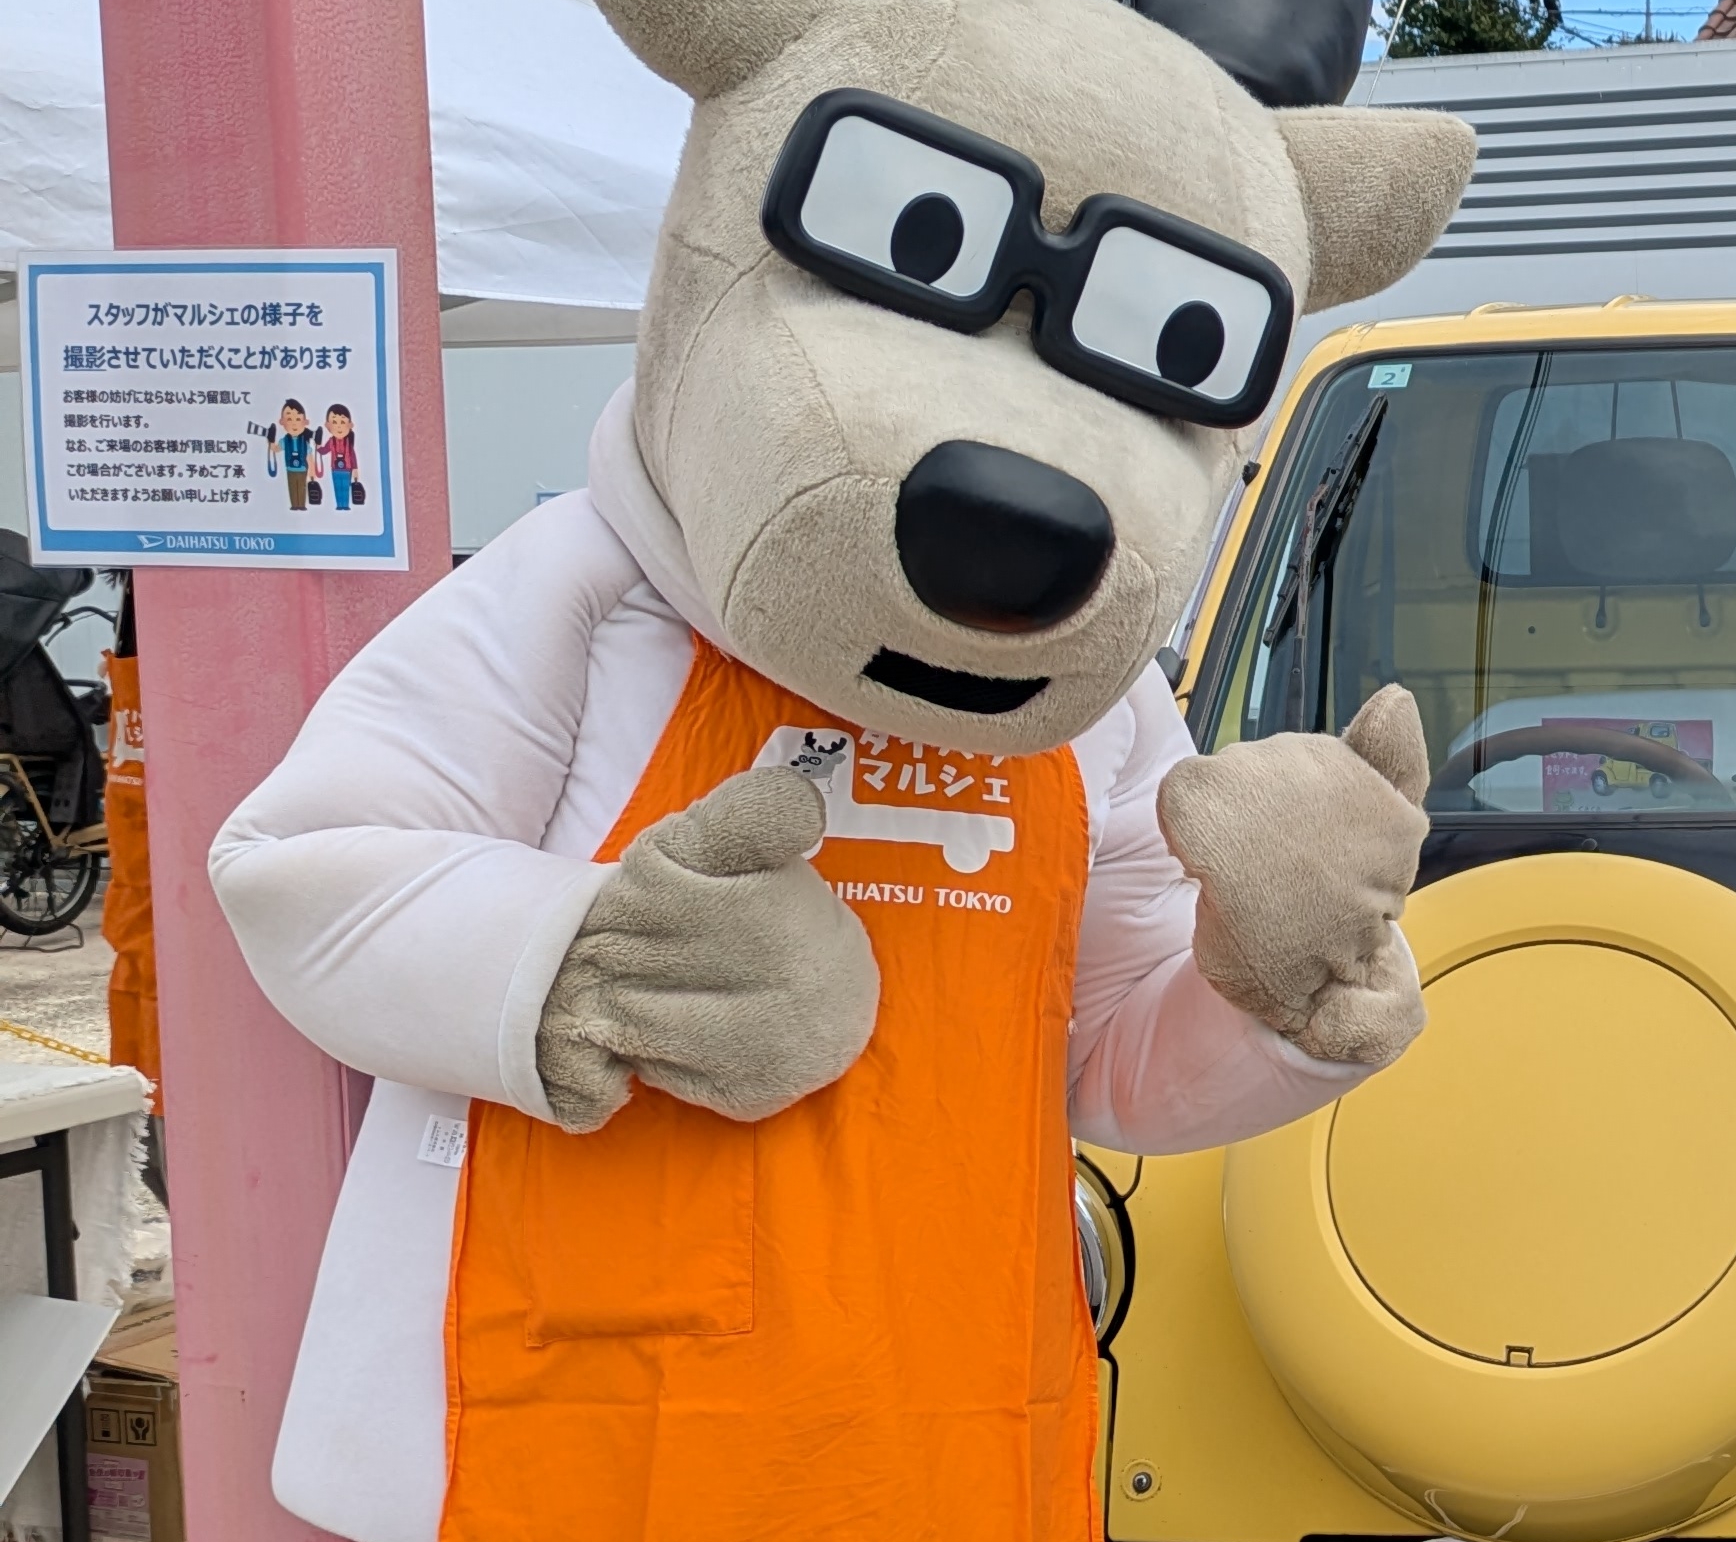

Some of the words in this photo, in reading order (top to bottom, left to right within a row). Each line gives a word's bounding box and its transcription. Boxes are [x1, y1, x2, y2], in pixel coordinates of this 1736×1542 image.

[87, 302, 324, 327] スタッフがマルシェの様子を
[63, 344, 352, 370] 撮影させていただくことがあります
[1380, 372, 1396, 386] 2
[63, 389, 251, 406] お客様の妨げにならないよう留意して
[64, 414, 150, 430] 撮影を行います。
[65, 438, 248, 455] なお、ご来場のお客様が背景に映り
[66, 463, 246, 480] こむ場合がございます。予めご了承
[68, 488, 252, 505] いただきますようお願い申し上げます
[166, 535, 229, 551] DAIHATSU
[233, 537, 275, 551] TOKYO
[859, 757, 1011, 805] マルシェ
[933, 887, 1012, 915] TOKYO
